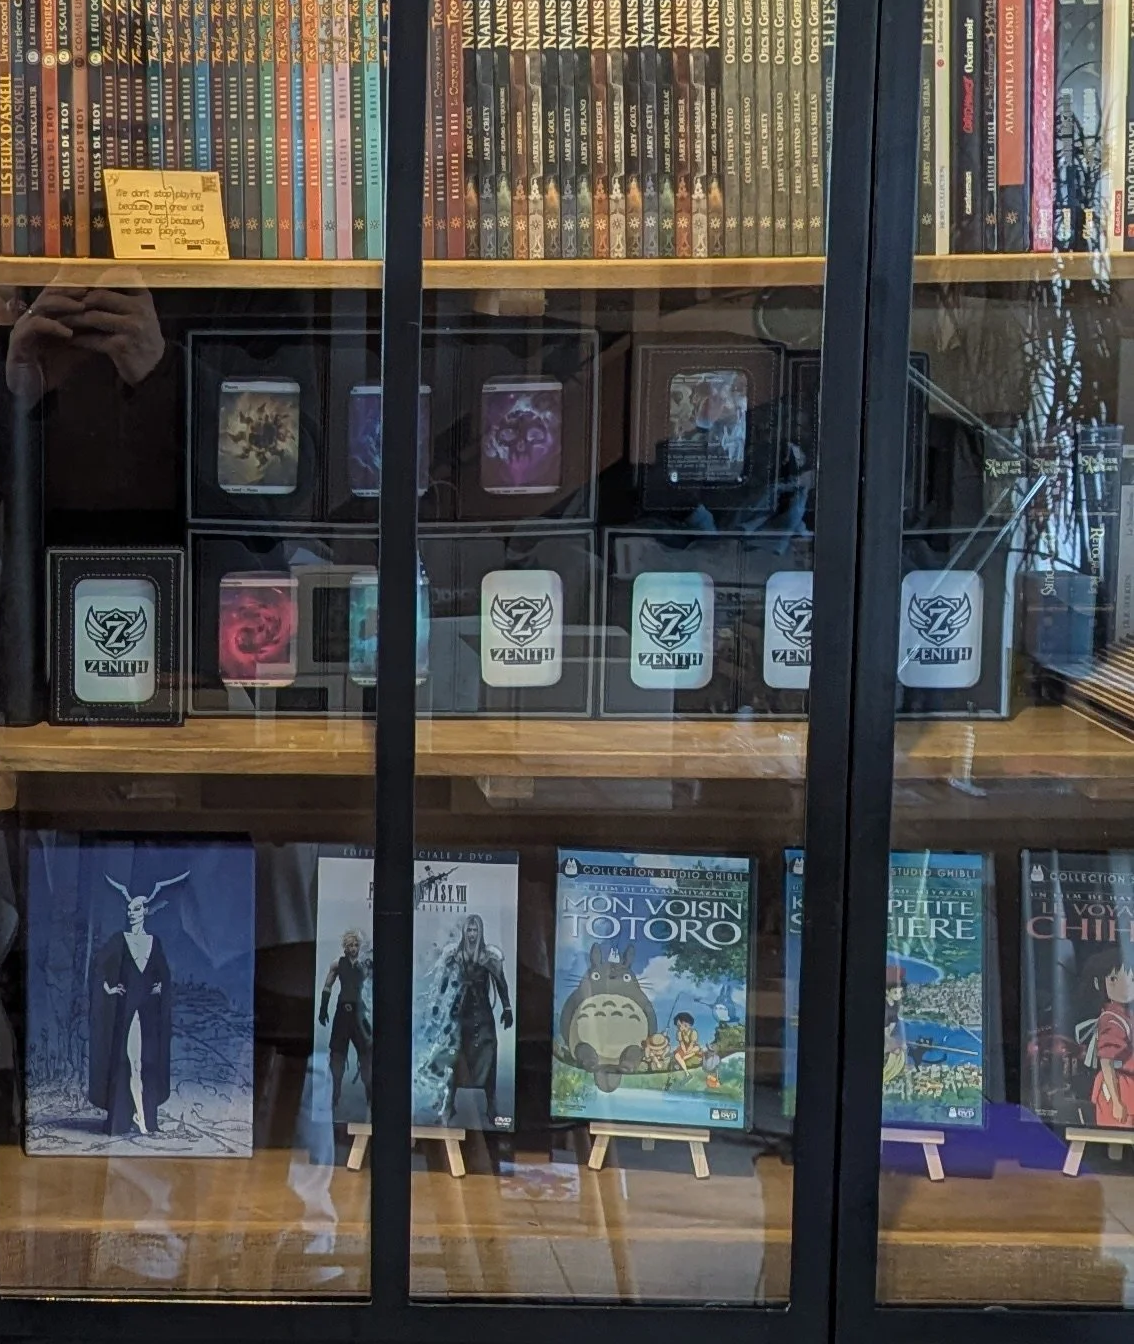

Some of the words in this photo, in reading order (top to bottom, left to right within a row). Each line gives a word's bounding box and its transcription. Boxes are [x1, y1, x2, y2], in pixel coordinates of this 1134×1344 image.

[0, 1, 8, 36] second
[59, 0, 67, 31] SCALP
[91, 14, 99, 32] FEU
[462, 0, 474, 49] NAINS
[478, 0, 491, 49] NAINS
[511, 1, 524, 50] NAINS
[527, 1, 540, 49] NAINS
[544, 0, 556, 49] NAINS
[559, 1, 572, 50] NAINS
[592, 0, 604, 49] NAINS
[608, 0, 621, 48] NAINS
[658, 0, 671, 48] NAINS
[691, 0, 703, 48] NAINS
[964, 18, 973, 39] noir
[0, 40, 8, 61] Livre
[14, 40, 23, 62] Livre
[964, 42, 973, 72] Océan
[1006, 59, 1013, 72] LA
[0, 74, 12, 133] D'ASKELL
[14, 74, 24, 134] D'ASKELL
[61, 102, 69, 130] TROY
[92, 103, 101, 131] TROY
[1006, 77, 1014, 133] ATALANTE
[46, 106, 54, 133] TROY
[1, 138, 12, 169] FEUX
[15, 138, 25, 169] FEUX
[1, 173, 13, 194] LES
[16, 173, 26, 195] LES
[47, 156, 55, 194] TROLLS
[62, 152, 70, 190] TROLLS
[93, 153, 101, 192] TROLLS
[87, 661, 146, 673] ZENITH
[493, 648, 552, 661] ZENITH
[641, 653, 700, 665] ZENITH
[774, 650, 811, 662] ZENI
[909, 648, 968, 660] ZENITH
[470, 852, 492, 861] DVD
[583, 865, 654, 877] COLLECTION
[660, 870, 699, 879] STUDIO
[706, 872, 743, 881] GHIBLI
[891, 868, 932, 877] STUDIO
[938, 869, 976, 878] GHIBLI
[1050, 872, 1125, 884] COLLECTION
[563, 896, 633, 914] MON
[645, 899, 741, 919] VOISIN
[889, 900, 974, 916] PETITE
[1074, 904, 1134, 916] VOYA
[563, 914, 741, 950] TOTORO
[1027, 916, 1134, 942] CHIH
